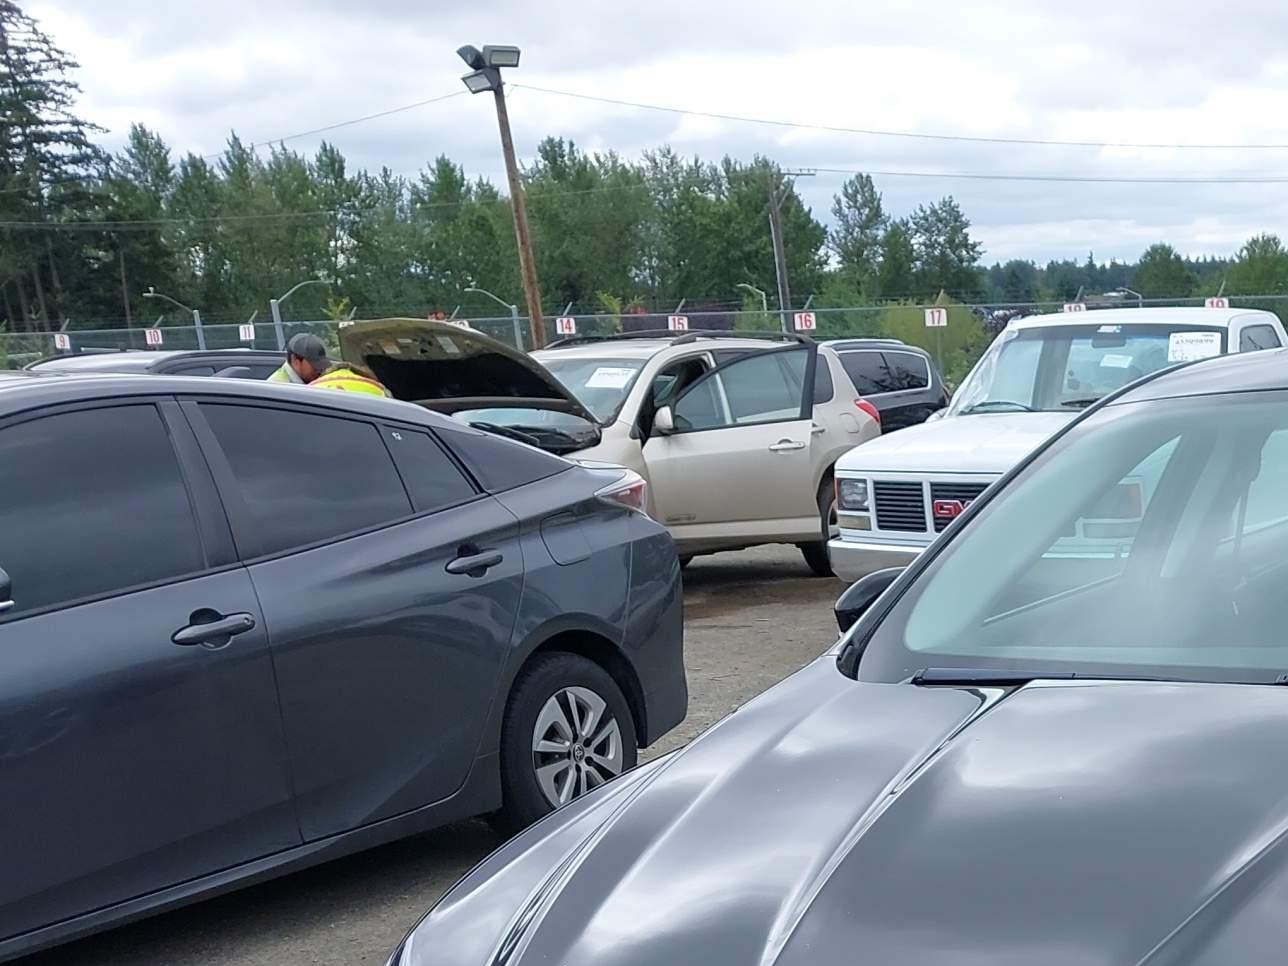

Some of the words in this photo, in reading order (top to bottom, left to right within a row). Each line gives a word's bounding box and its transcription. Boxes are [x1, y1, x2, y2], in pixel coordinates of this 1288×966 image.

[671, 316, 685, 330] 15
[797, 313, 812, 329] 16
[929, 310, 942, 325] 17
[242, 324, 251, 339] 11
[558, 318, 573, 333] 14
[57, 334, 66, 348] 9
[148, 329, 160, 343] 10
